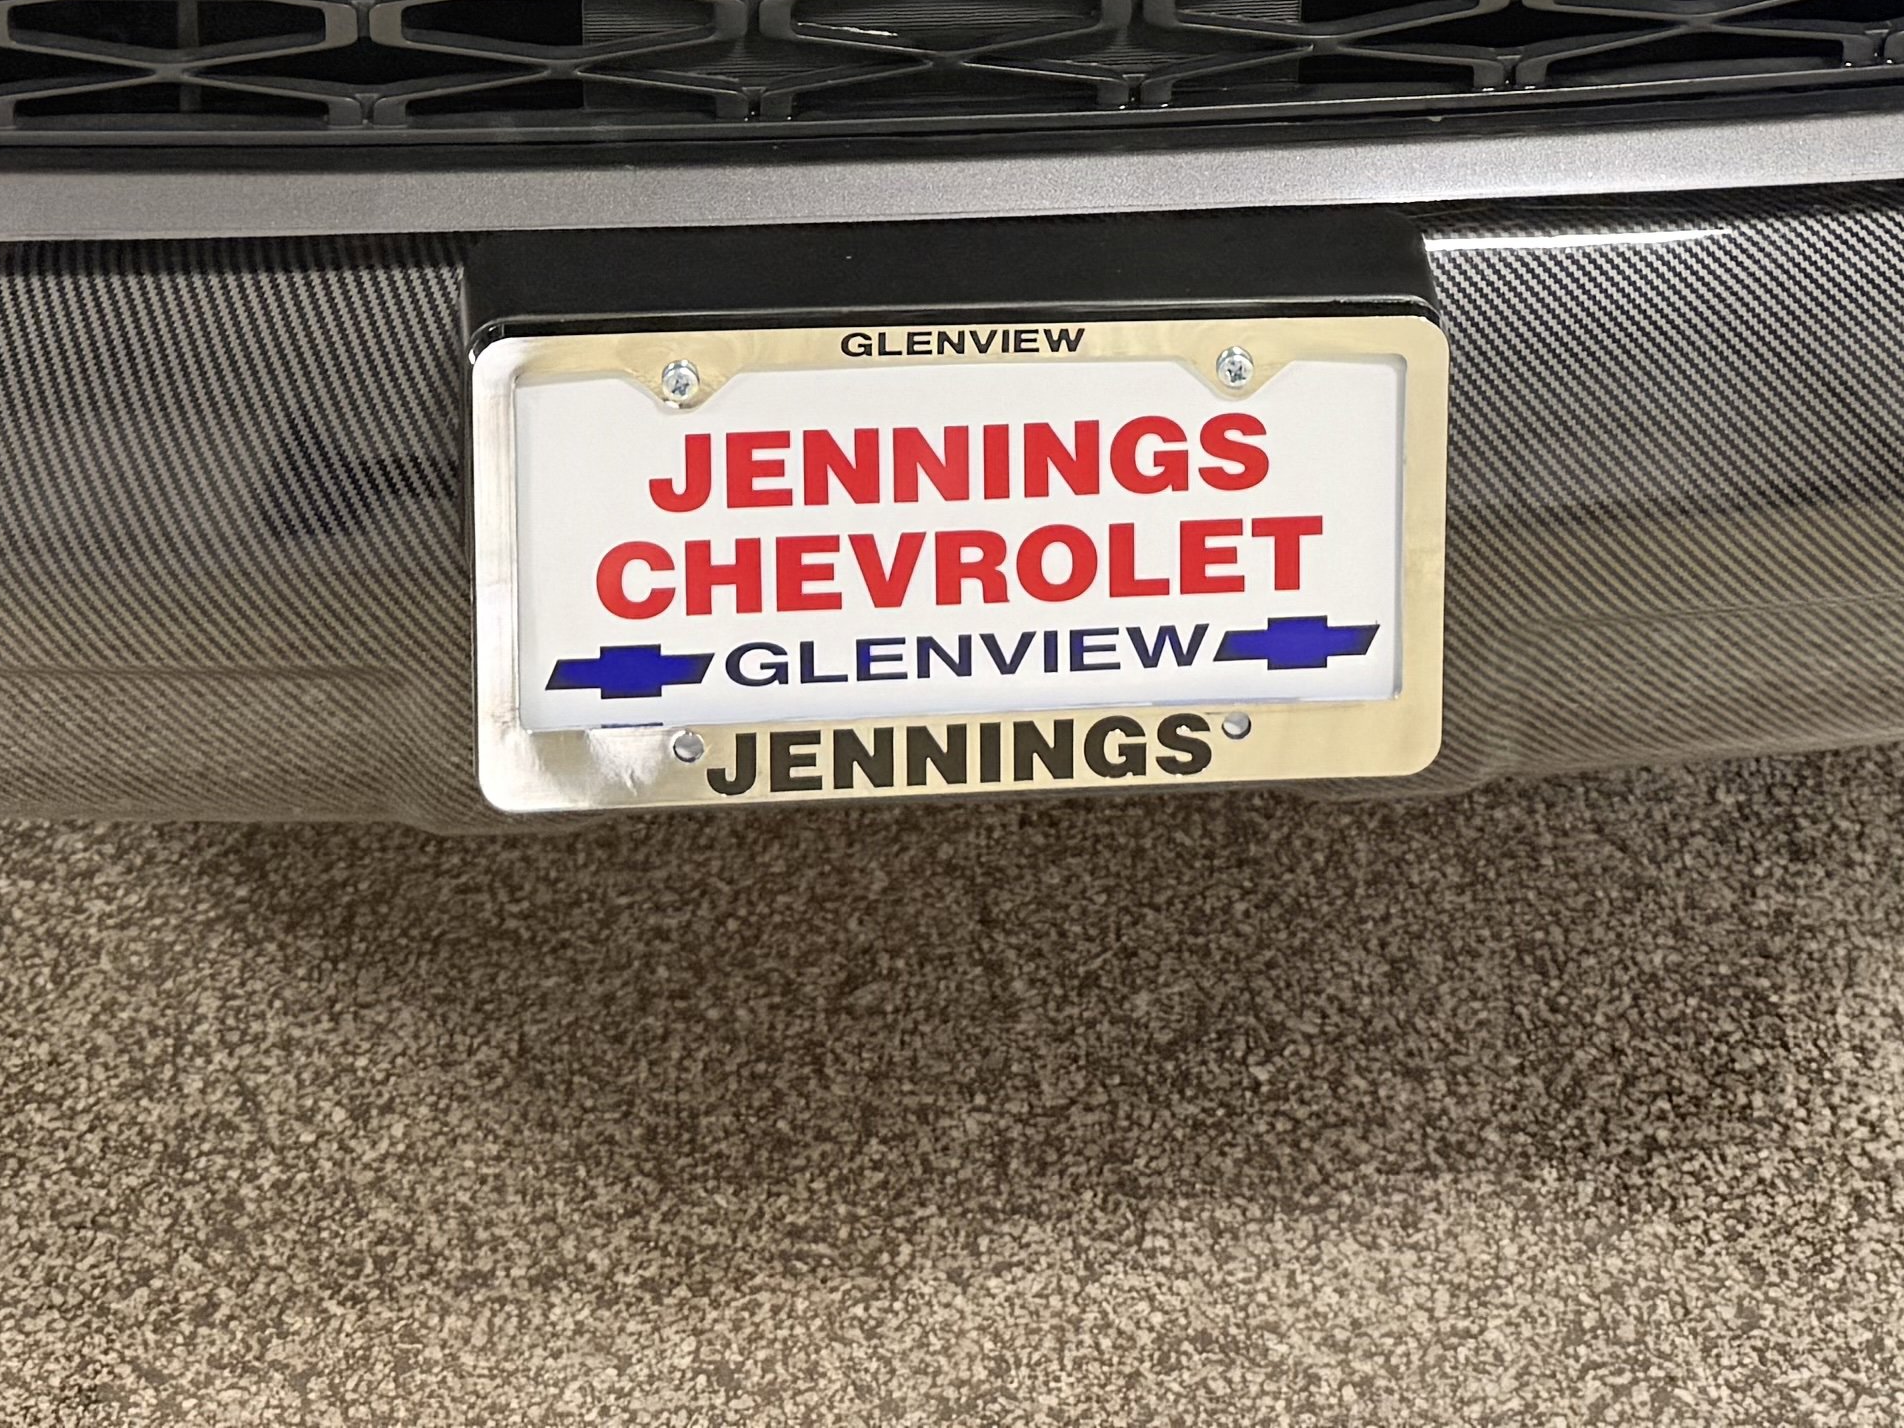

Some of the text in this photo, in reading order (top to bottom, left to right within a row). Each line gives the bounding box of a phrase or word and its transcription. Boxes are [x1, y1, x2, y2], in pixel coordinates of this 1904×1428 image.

[840, 327, 1086, 358] GLENVIEW
[648, 413, 1271, 515] JENNINGS
[595, 515, 1324, 621] CHEVROLET
[724, 623, 1210, 687] GLENVIEW
[705, 713, 1213, 797] JENNINGS
